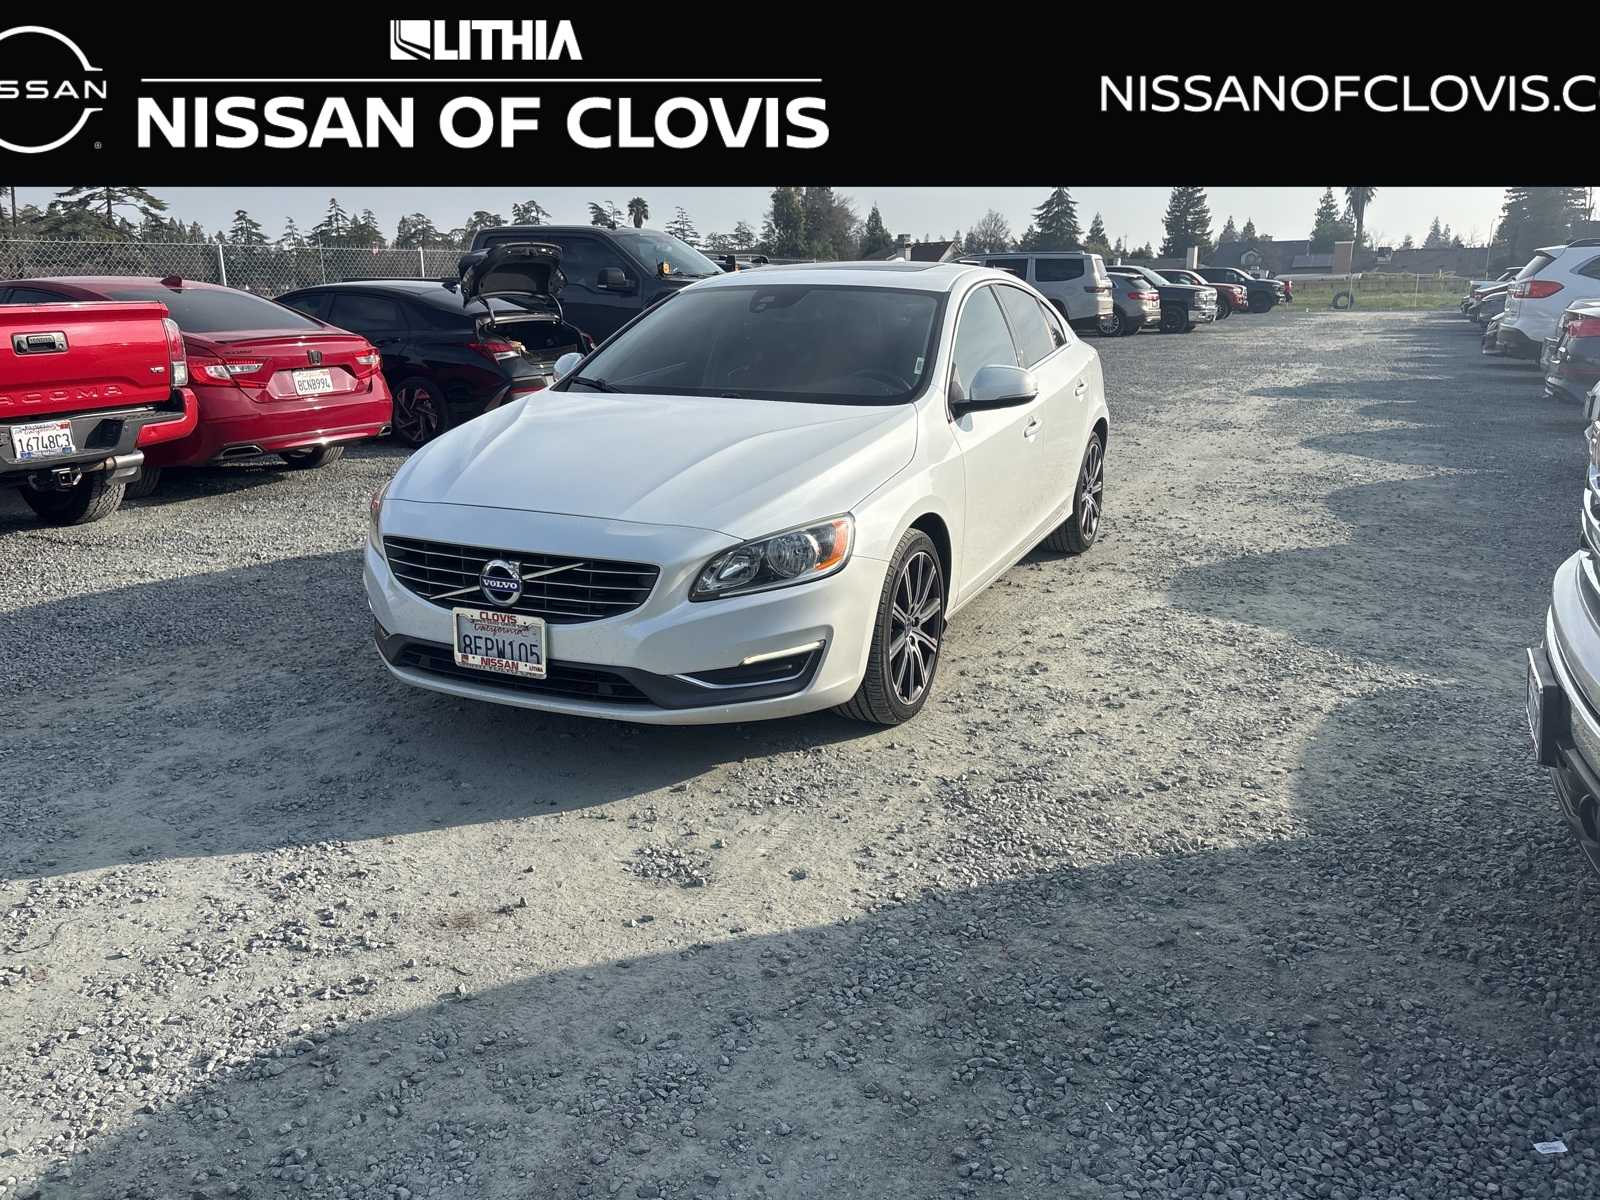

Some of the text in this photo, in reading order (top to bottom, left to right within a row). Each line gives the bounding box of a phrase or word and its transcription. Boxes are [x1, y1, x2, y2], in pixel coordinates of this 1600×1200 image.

[18, 433, 71, 453] 16748C3
[483, 579, 518, 589] VOLVO
[480, 612, 517, 624] CLOVIS
[480, 657, 519, 671] NISSAN
